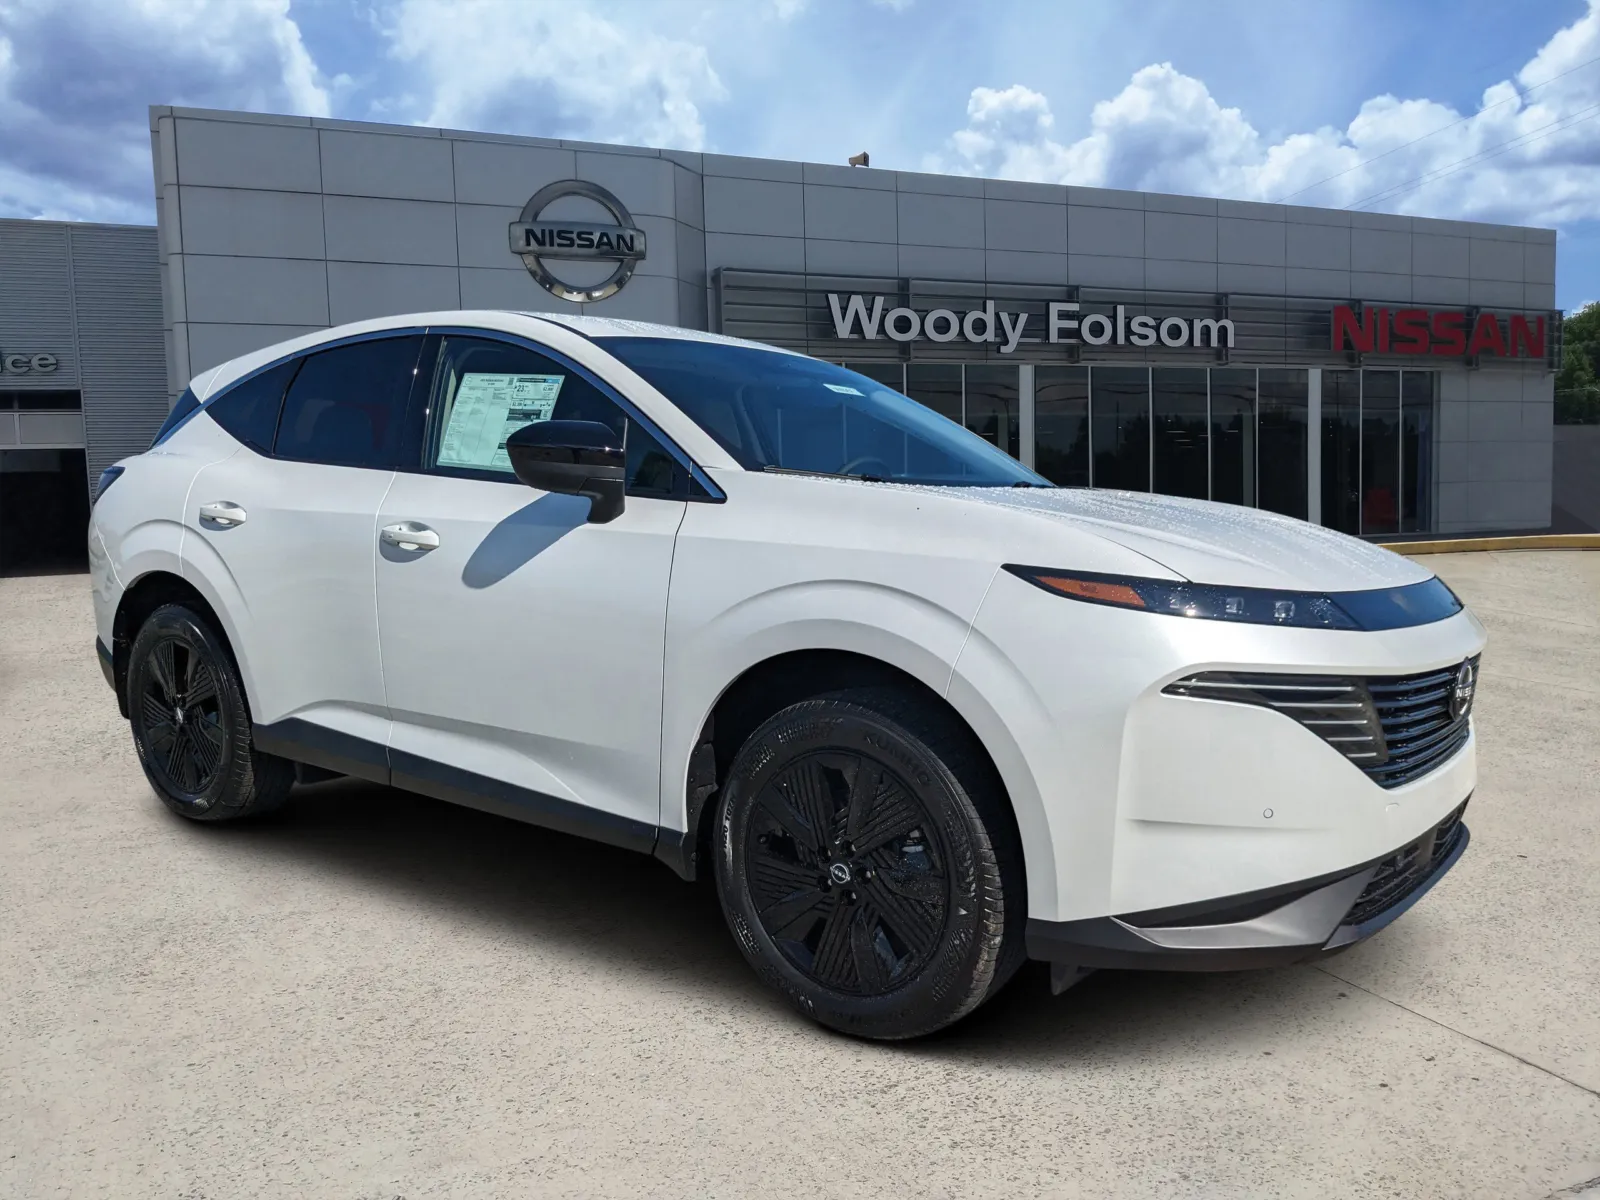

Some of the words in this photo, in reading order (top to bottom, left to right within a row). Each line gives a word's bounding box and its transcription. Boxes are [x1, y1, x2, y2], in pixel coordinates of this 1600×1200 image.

[524, 228, 634, 252] NISSAN
[826, 293, 1028, 354] Woody
[1048, 301, 1235, 348] Folsom
[1333, 305, 1545, 358] NISSAN
[0, 353, 57, 374] ce
